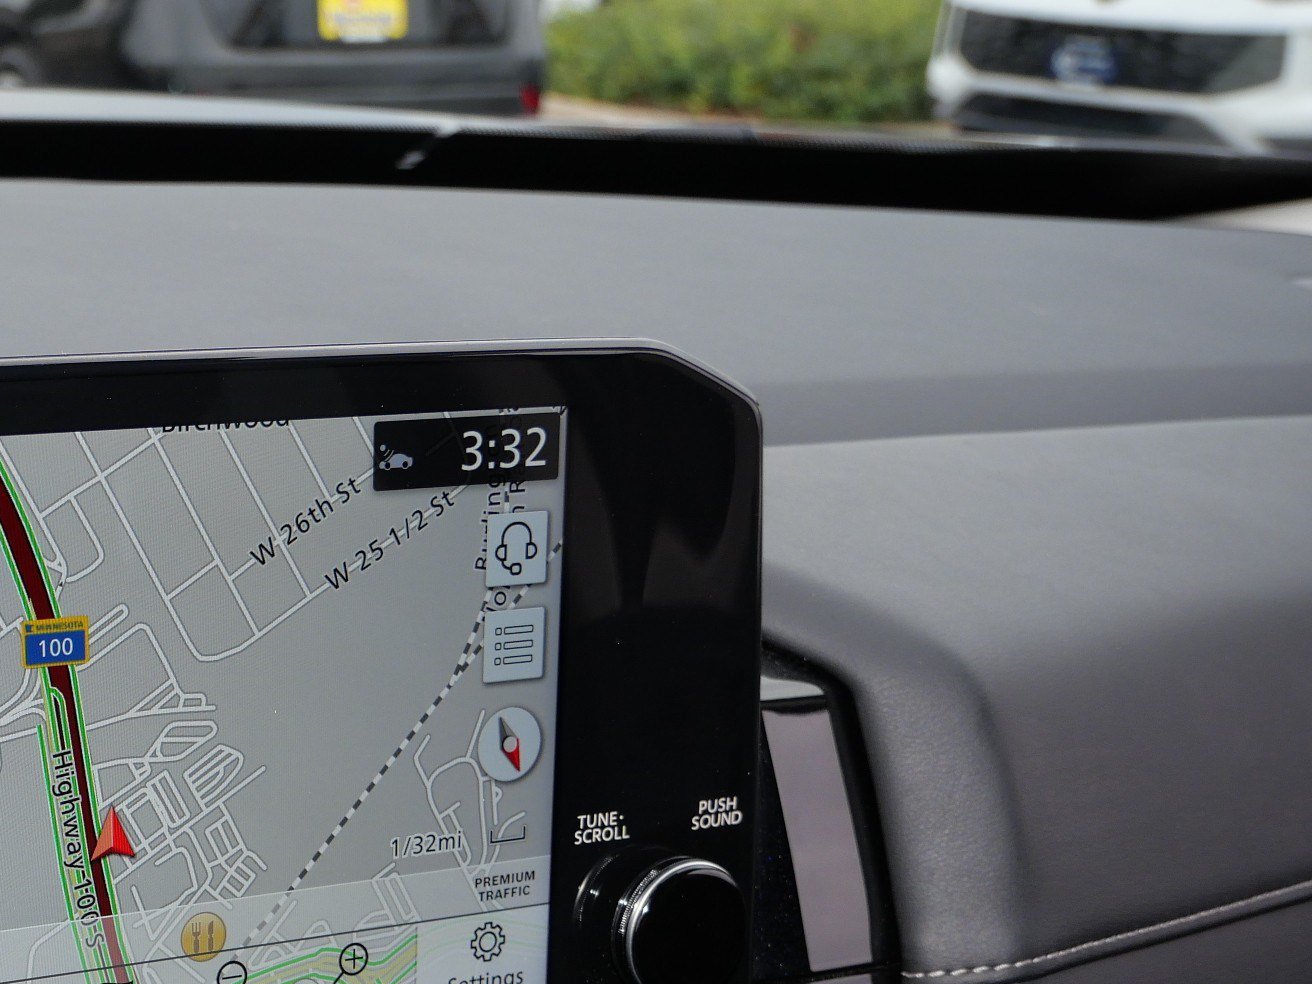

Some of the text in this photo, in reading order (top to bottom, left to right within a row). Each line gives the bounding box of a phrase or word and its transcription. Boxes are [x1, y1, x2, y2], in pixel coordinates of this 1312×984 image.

[461, 426, 549, 472] 3:32
[250, 475, 362, 567] W 26th St
[324, 562, 352, 591] W
[355, 540, 386, 572] 25
[429, 489, 455, 518] St
[39, 637, 74, 658] 100
[52, 752, 83, 873] Highway
[698, 796, 738, 815] PUSH
[691, 810, 744, 831] SOUND
[574, 825, 631, 845] SCROLL
[474, 870, 537, 889] PREMIUM
[478, 884, 531, 902] TRAFFIC
